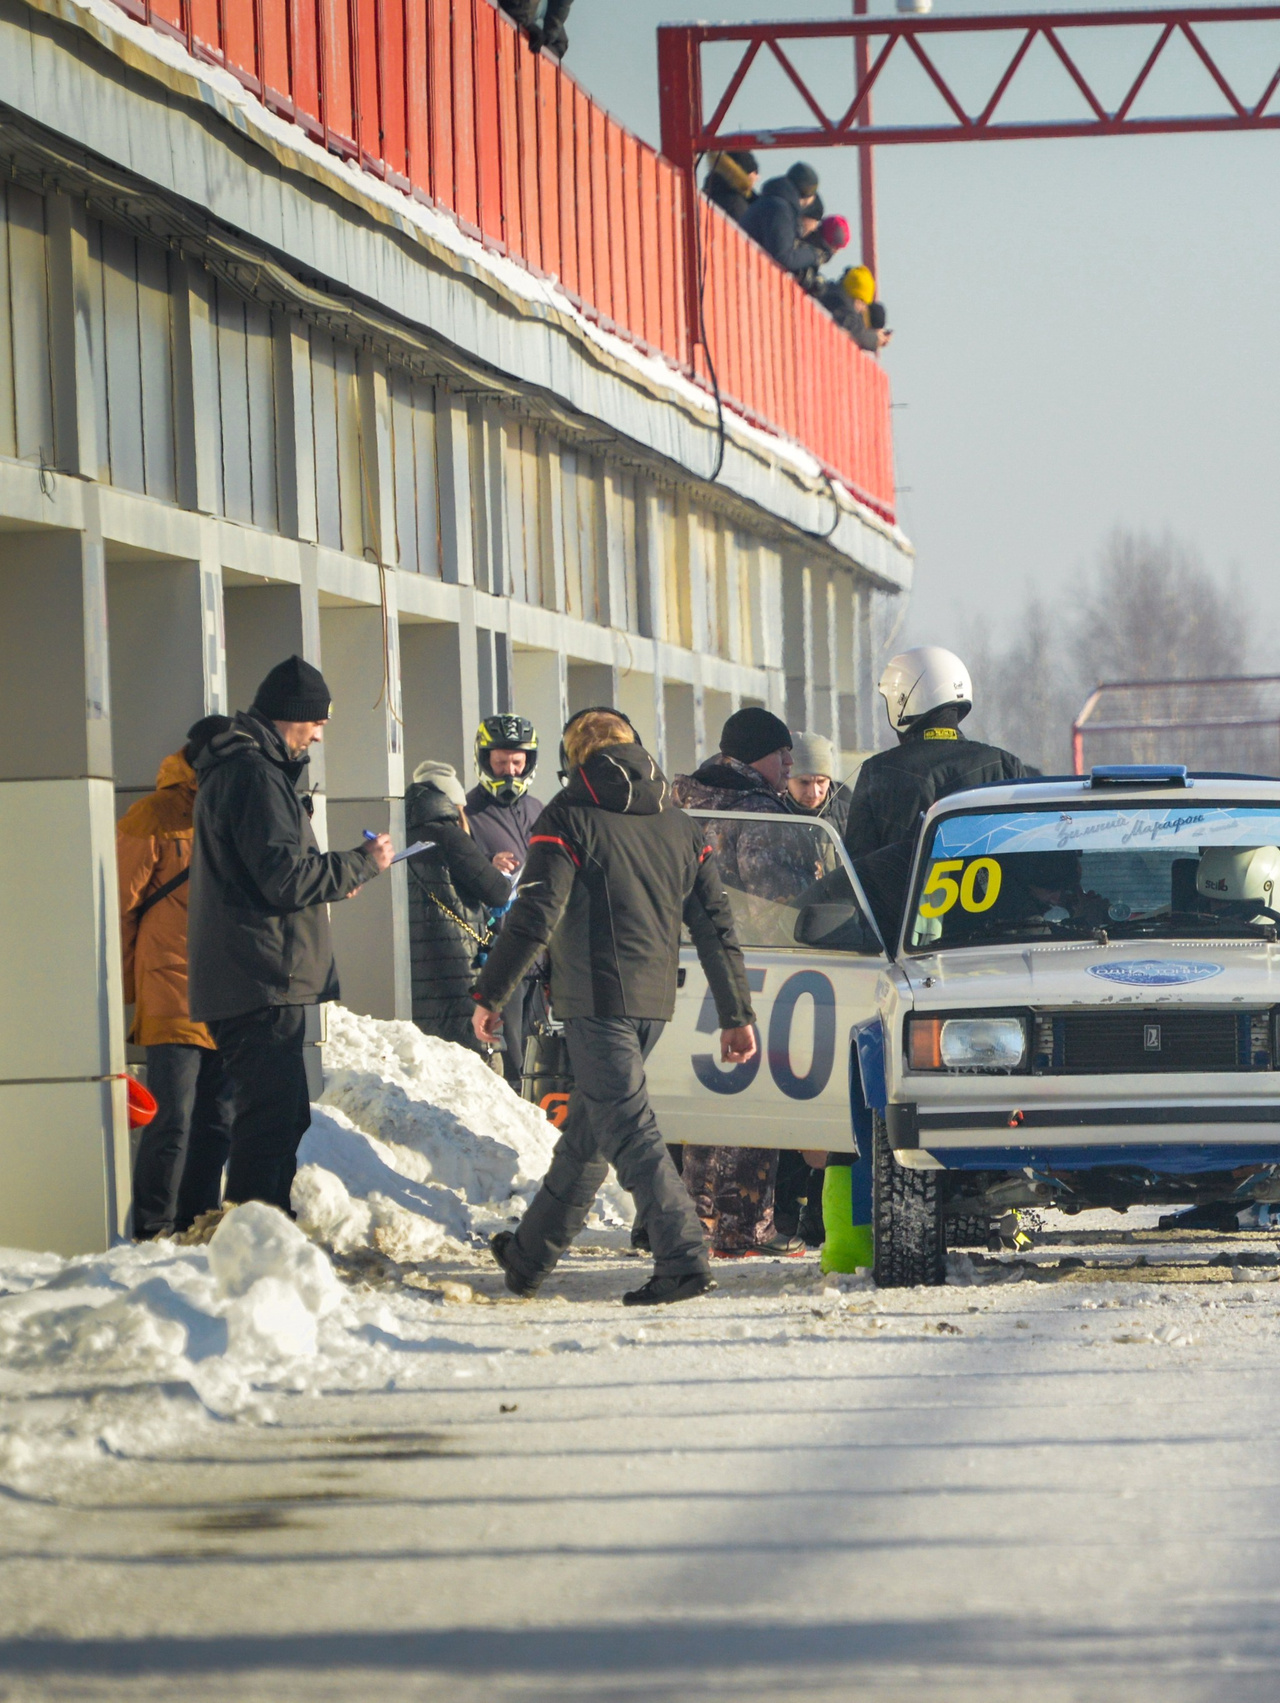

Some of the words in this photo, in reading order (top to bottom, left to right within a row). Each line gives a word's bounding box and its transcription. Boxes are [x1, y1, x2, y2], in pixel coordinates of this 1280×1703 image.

[1122, 814, 1205, 844] Марафон
[919, 857, 1002, 918] 50
[691, 968, 836, 1101] 50
